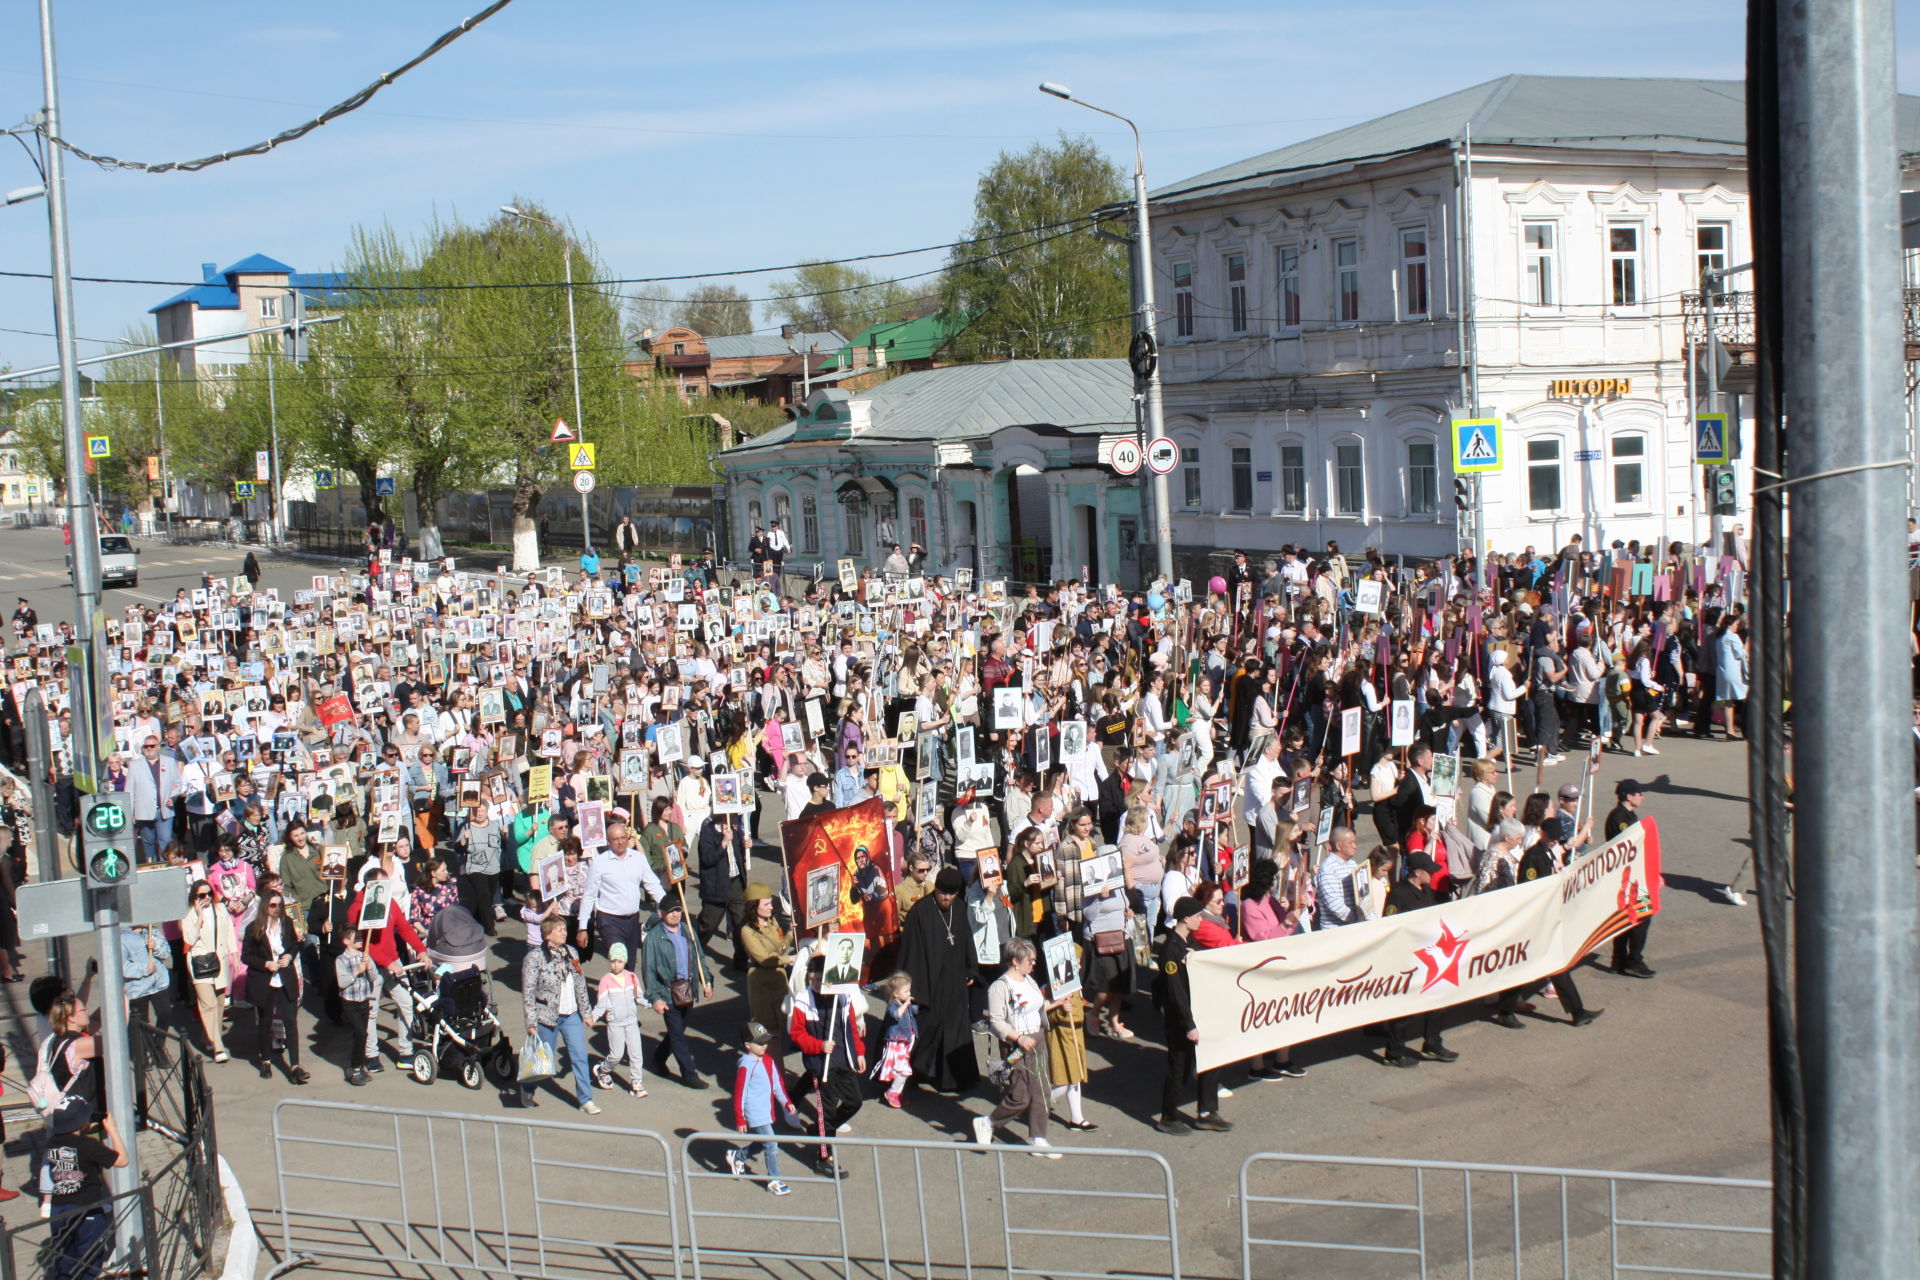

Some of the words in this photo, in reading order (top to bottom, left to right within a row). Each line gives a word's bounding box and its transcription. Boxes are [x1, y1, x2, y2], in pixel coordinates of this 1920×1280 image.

[1554, 378, 1632, 396] ШТОРЫ
[1119, 450, 1134, 463] 40
[579, 478, 590, 486] 20
[95, 805, 124, 829] 28
[1468, 939, 1531, 979] ПОЛК
